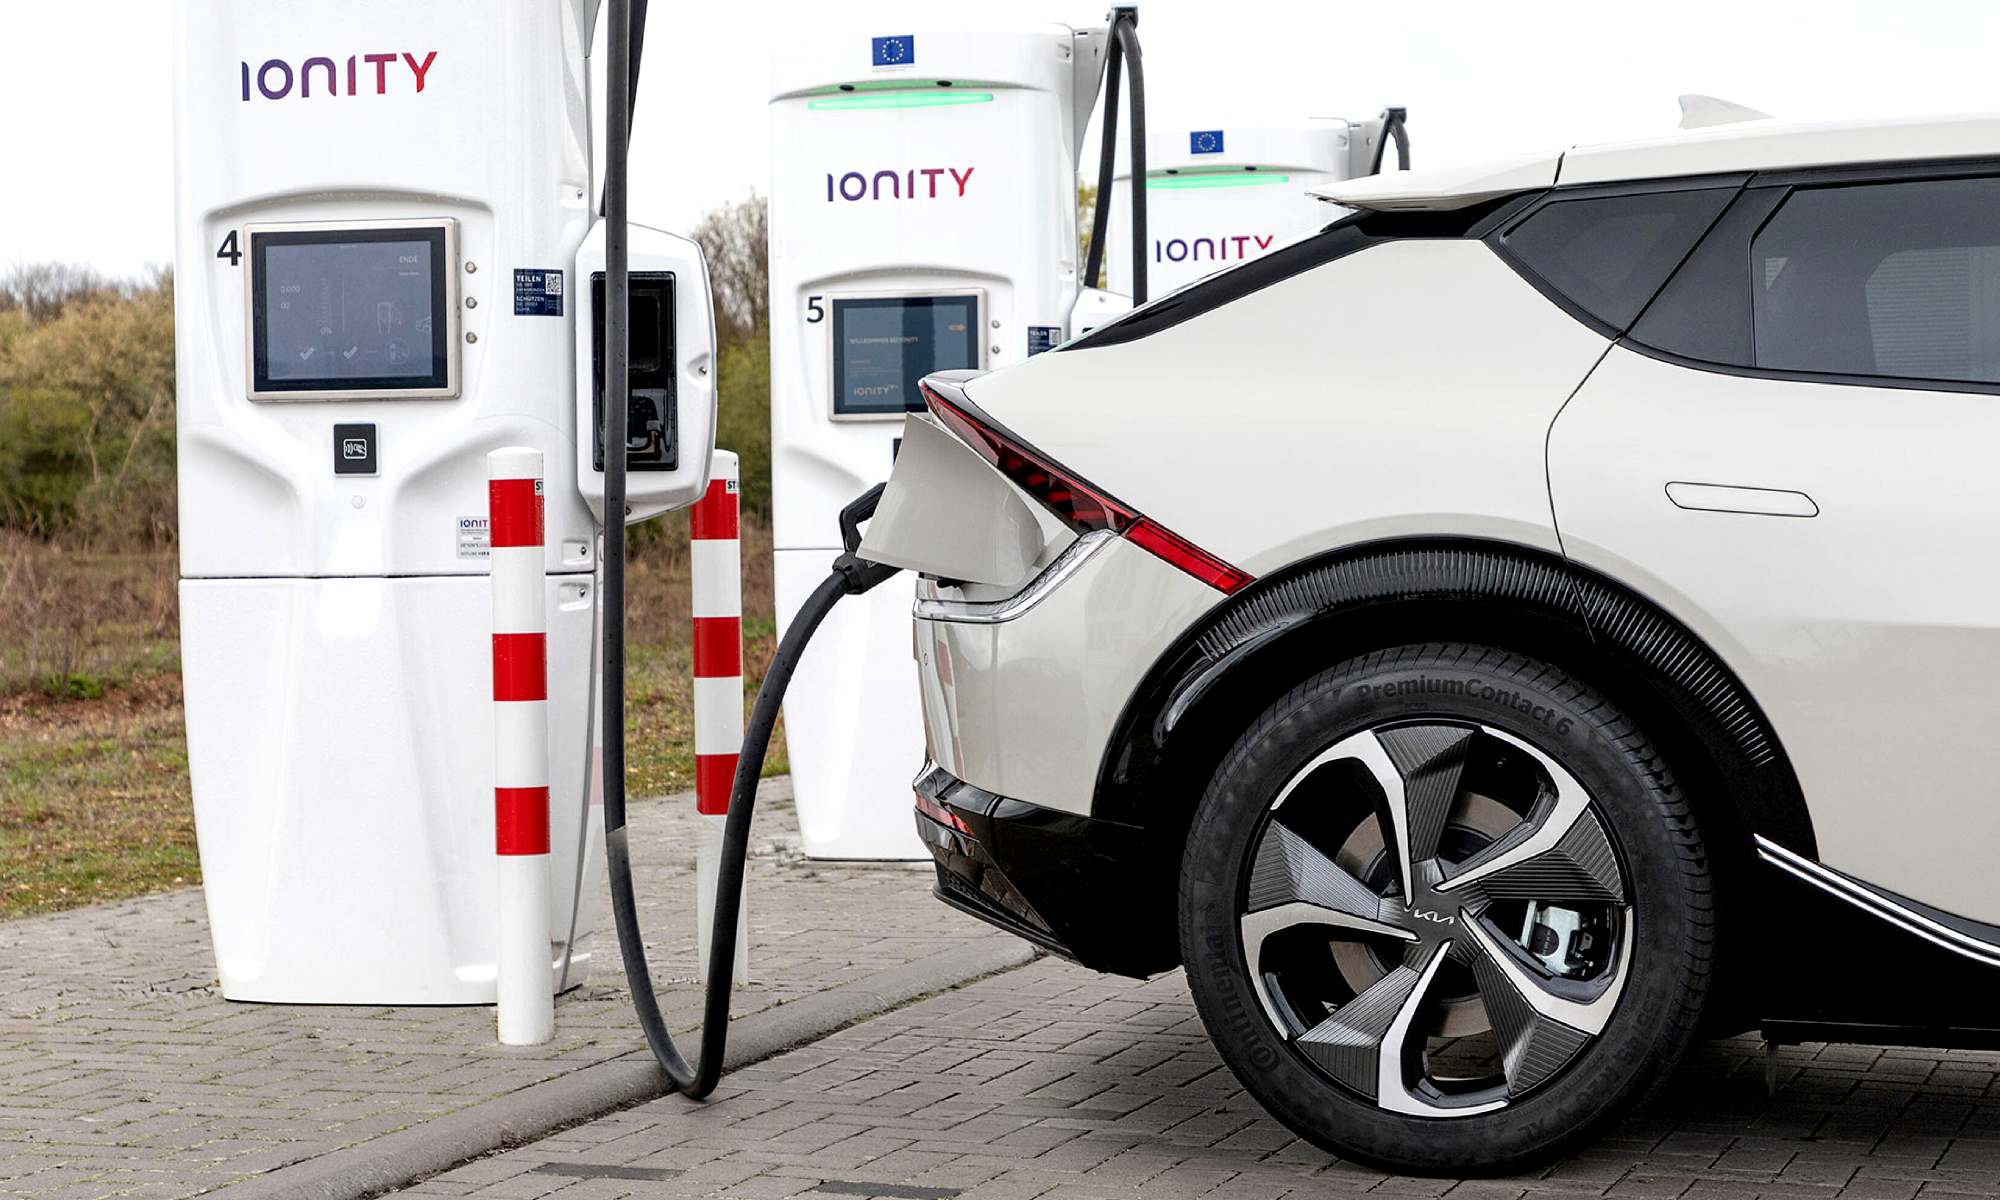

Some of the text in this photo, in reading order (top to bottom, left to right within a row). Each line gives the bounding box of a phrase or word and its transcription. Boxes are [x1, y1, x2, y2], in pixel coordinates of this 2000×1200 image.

[242, 51, 438, 102] IONITY
[827, 167, 975, 202] IONITY
[217, 229, 242, 266] 4
[399, 255, 419, 264] ENDE
[807, 296, 824, 323] 5
[854, 386, 889, 397] IONITY
[460, 519, 488, 528] IONIT
[1357, 675, 1575, 736] PremiumContact 6
